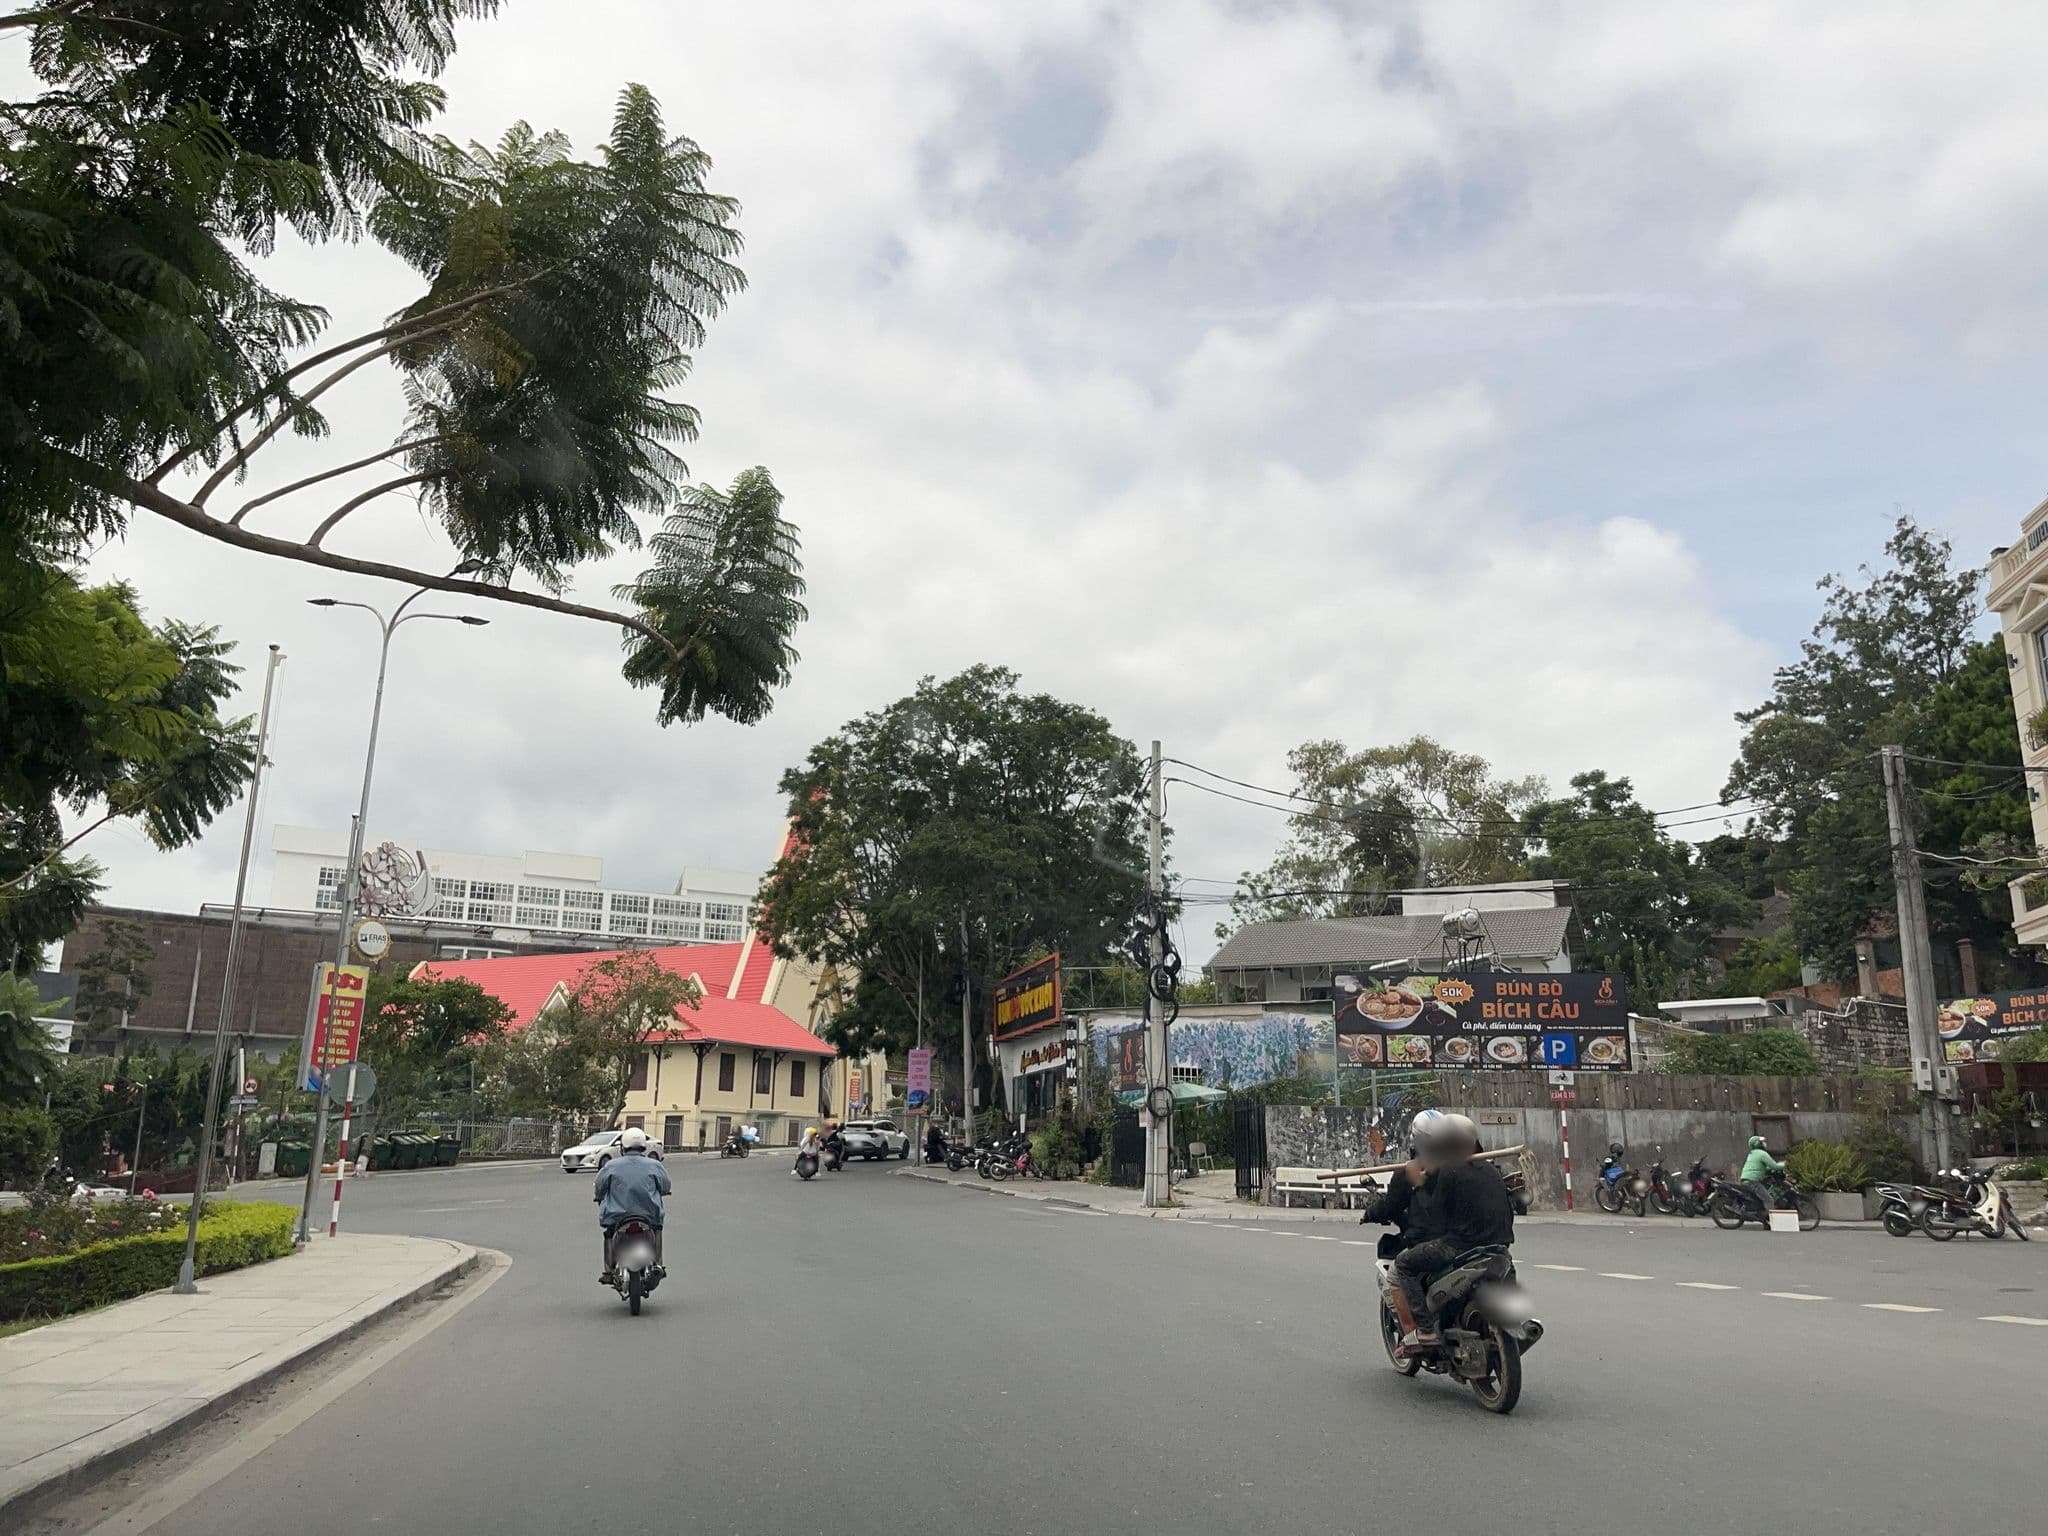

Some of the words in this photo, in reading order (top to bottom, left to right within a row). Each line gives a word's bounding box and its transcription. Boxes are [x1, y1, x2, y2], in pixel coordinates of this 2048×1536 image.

[1441, 987, 1463, 997] 50K
[1496, 979, 1533, 996] BÚN
[1538, 978, 1563, 996] BÒ
[1482, 998, 1531, 1019] BÍCH
[1537, 998, 1580, 1019] CÂU
[2010, 994, 2035, 1008] BÚN
[2002, 1009, 2035, 1025] BÍCH
[1552, 1039, 1567, 1059] P
